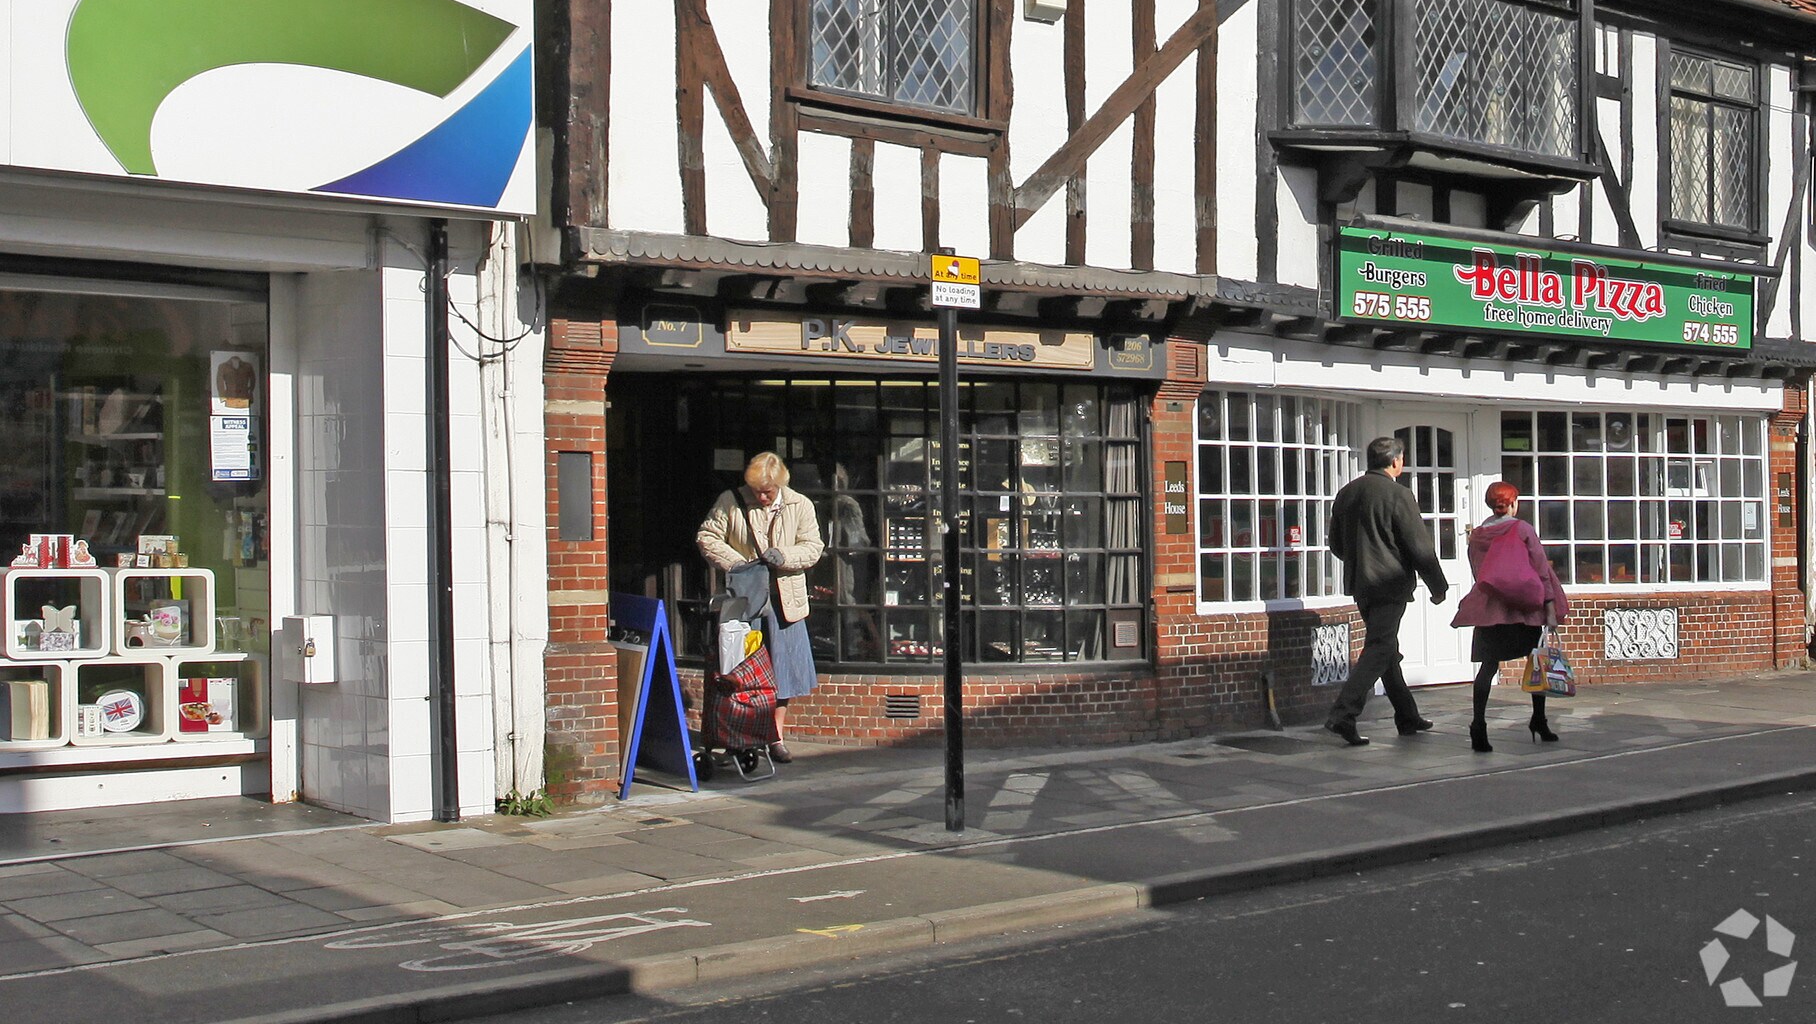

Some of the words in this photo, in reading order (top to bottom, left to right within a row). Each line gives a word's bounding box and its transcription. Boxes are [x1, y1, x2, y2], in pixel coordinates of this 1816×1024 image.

[1367, 234, 1423, 260] Grilled
[935, 270, 944, 278] At
[1357, 261, 1427, 290] Burgers
[1453, 247, 1565, 308] Bella
[1571, 258, 1666, 323] Pizza
[1695, 272, 1727, 292] Fried
[936, 285, 947, 293] No
[949, 286, 976, 296] loading
[945, 296, 958, 304] any
[960, 296, 976, 304] time
[1353, 290, 1391, 317] 575
[1394, 294, 1431, 321] 555
[1687, 293, 1734, 319] Chicken
[657, 320, 676, 331] No.
[680, 321, 688, 332] 7
[1483, 302, 1516, 323] free
[1517, 304, 1556, 328] home
[1558, 309, 1613, 336] delivery
[1682, 321, 1710, 344] 574
[1712, 323, 1739, 346] 555
[874, 335, 1036, 362] JEWLERS
[1164, 480, 1185, 493] Leeds
[1164, 501, 1187, 515] House
